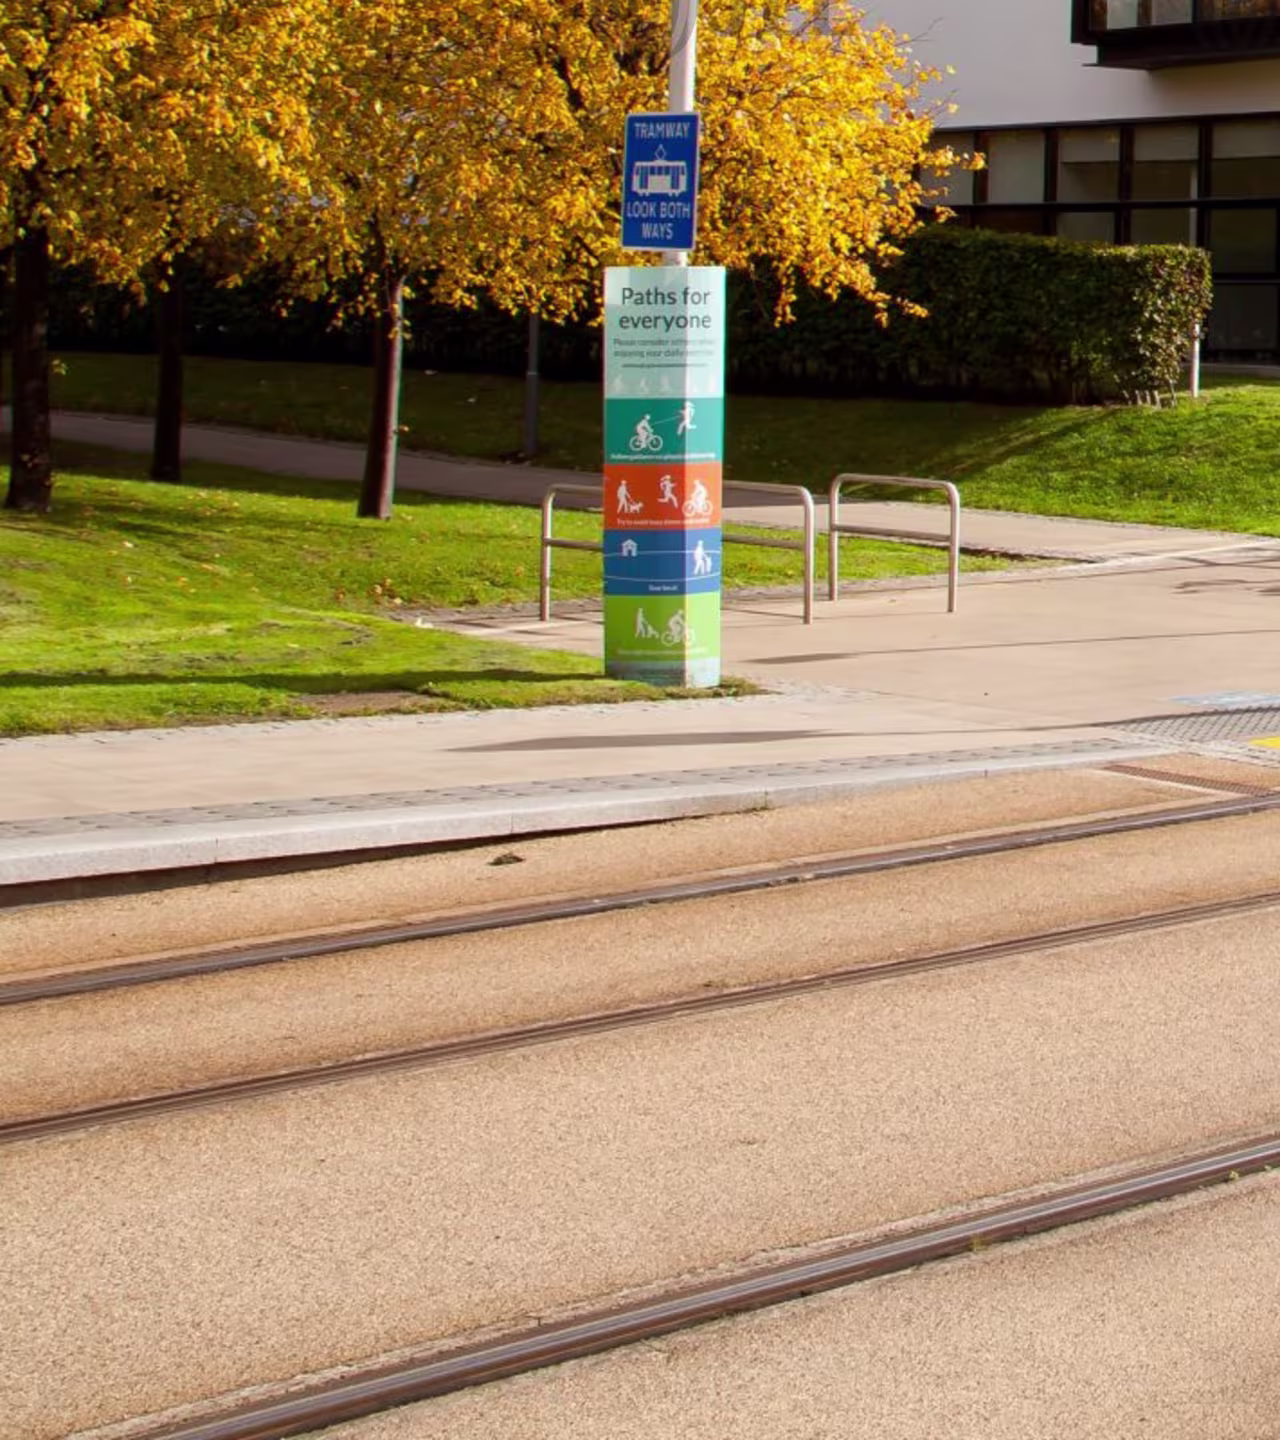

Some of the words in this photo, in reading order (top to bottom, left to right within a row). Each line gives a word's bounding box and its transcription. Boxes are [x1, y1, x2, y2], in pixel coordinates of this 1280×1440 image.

[634, 122, 690, 138] TRAMWAY
[627, 201, 657, 218] LOOK
[660, 202, 690, 219] BOTH
[642, 222, 673, 239] WAYS
[621, 286, 677, 305] Paths
[682, 286, 710, 305] for
[618, 315, 712, 333] everyone
